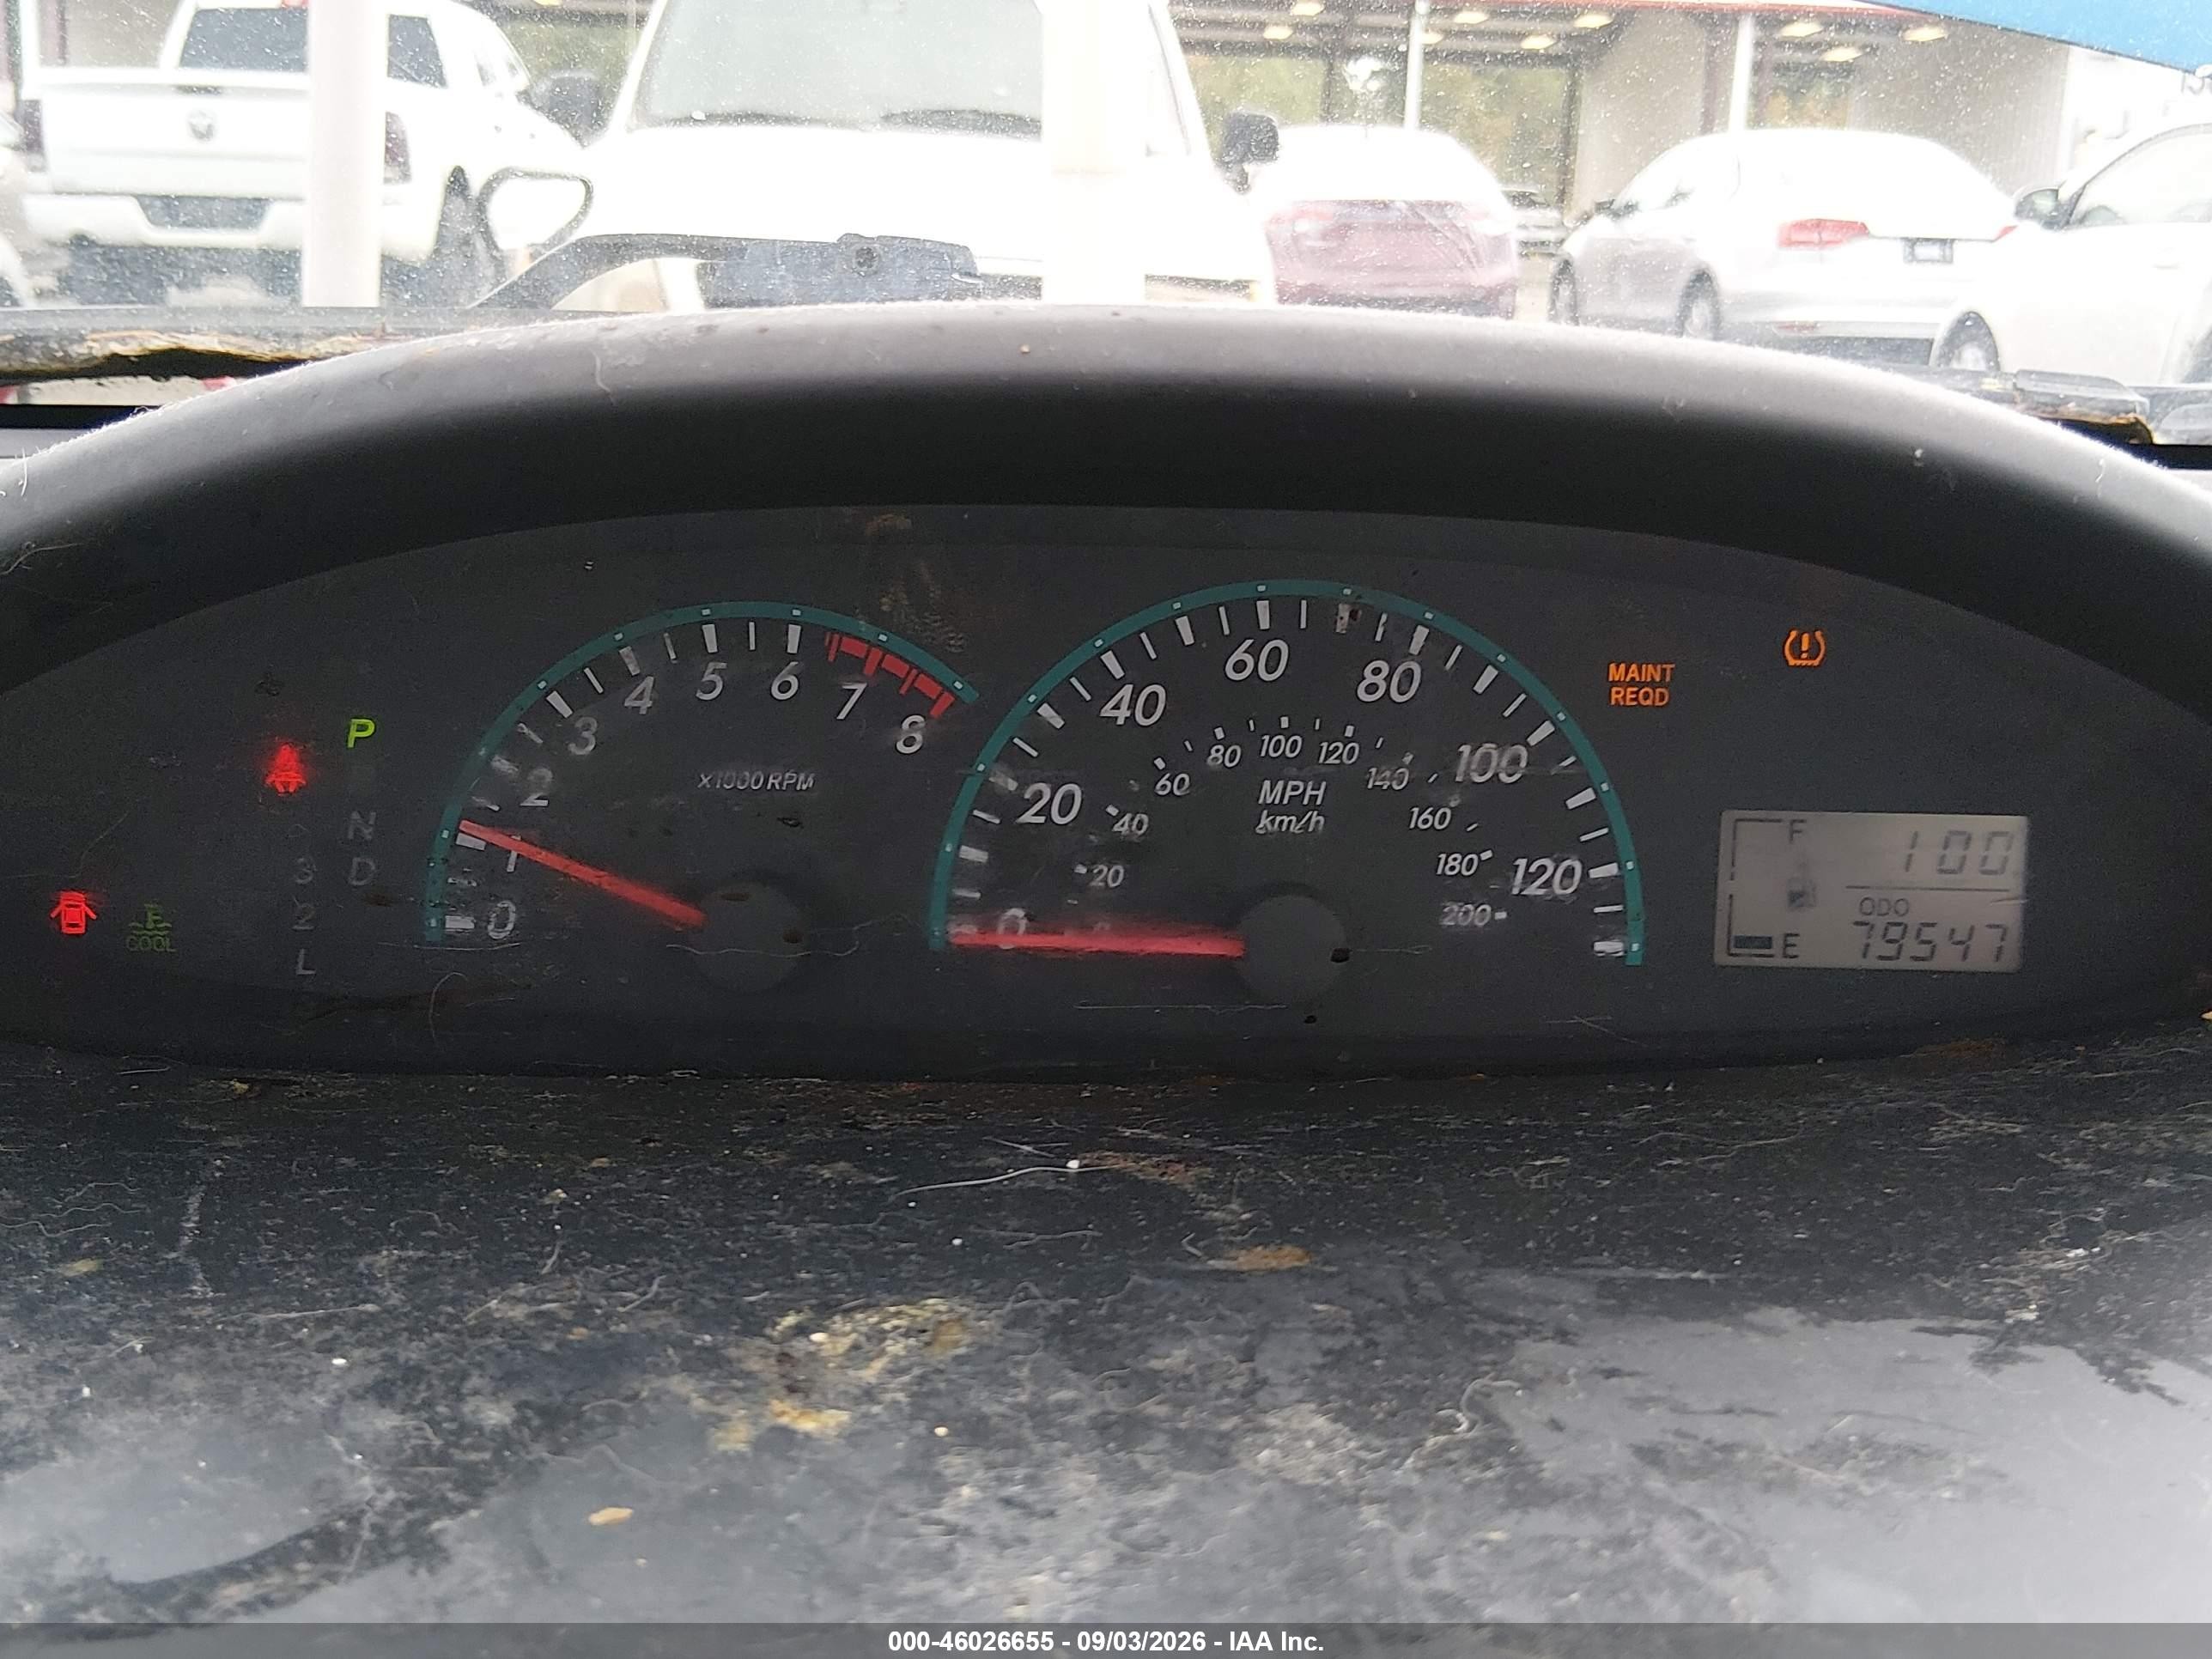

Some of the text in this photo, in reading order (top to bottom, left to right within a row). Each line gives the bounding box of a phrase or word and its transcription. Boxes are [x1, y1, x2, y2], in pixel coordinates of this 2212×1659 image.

[1224, 639, 1289, 681] 60
[1608, 663, 1675, 683] MAINT
[696, 662, 726, 701] 5
[770, 662, 801, 701] 6
[1357, 660, 1421, 702] 80
[624, 676, 654, 714] 4
[837, 683, 867, 720] 7
[1100, 684, 1166, 726] 40
[1609, 688, 1669, 707] REQD
[347, 718, 376, 748] P
[568, 717, 599, 755] 3
[896, 714, 925, 754] 8
[1261, 735, 1303, 758] 100
[1207, 744, 1242, 768] 80
[1318, 742, 1360, 765] 120
[1455, 744, 1528, 784] 100
[520, 769, 554, 807] 2
[767, 770, 815, 790] RPM
[1155, 774, 1191, 796] 60
[1258, 780, 1327, 805] MPH
[1367, 768, 1410, 790] 140
[1017, 783, 1082, 825] 20
[348, 811, 376, 840] N
[1112, 812, 1149, 836] 40
[1255, 810, 1325, 834] km/h
[1409, 807, 1452, 830] 160
[1789, 819, 1807, 843] F
[1436, 854, 1479, 876] 180
[1905, 830, 2014, 875] 100
[349, 858, 376, 886] D
[1090, 866, 1125, 888] 20
[1511, 858, 1583, 896] 120
[487, 900, 517, 939] 0
[1440, 903, 1492, 927] 200
[1859, 897, 1910, 916] ODO
[1782, 933, 1800, 959] E
[1852, 921, 2008, 962] 79547
[295, 948, 317, 975] L
